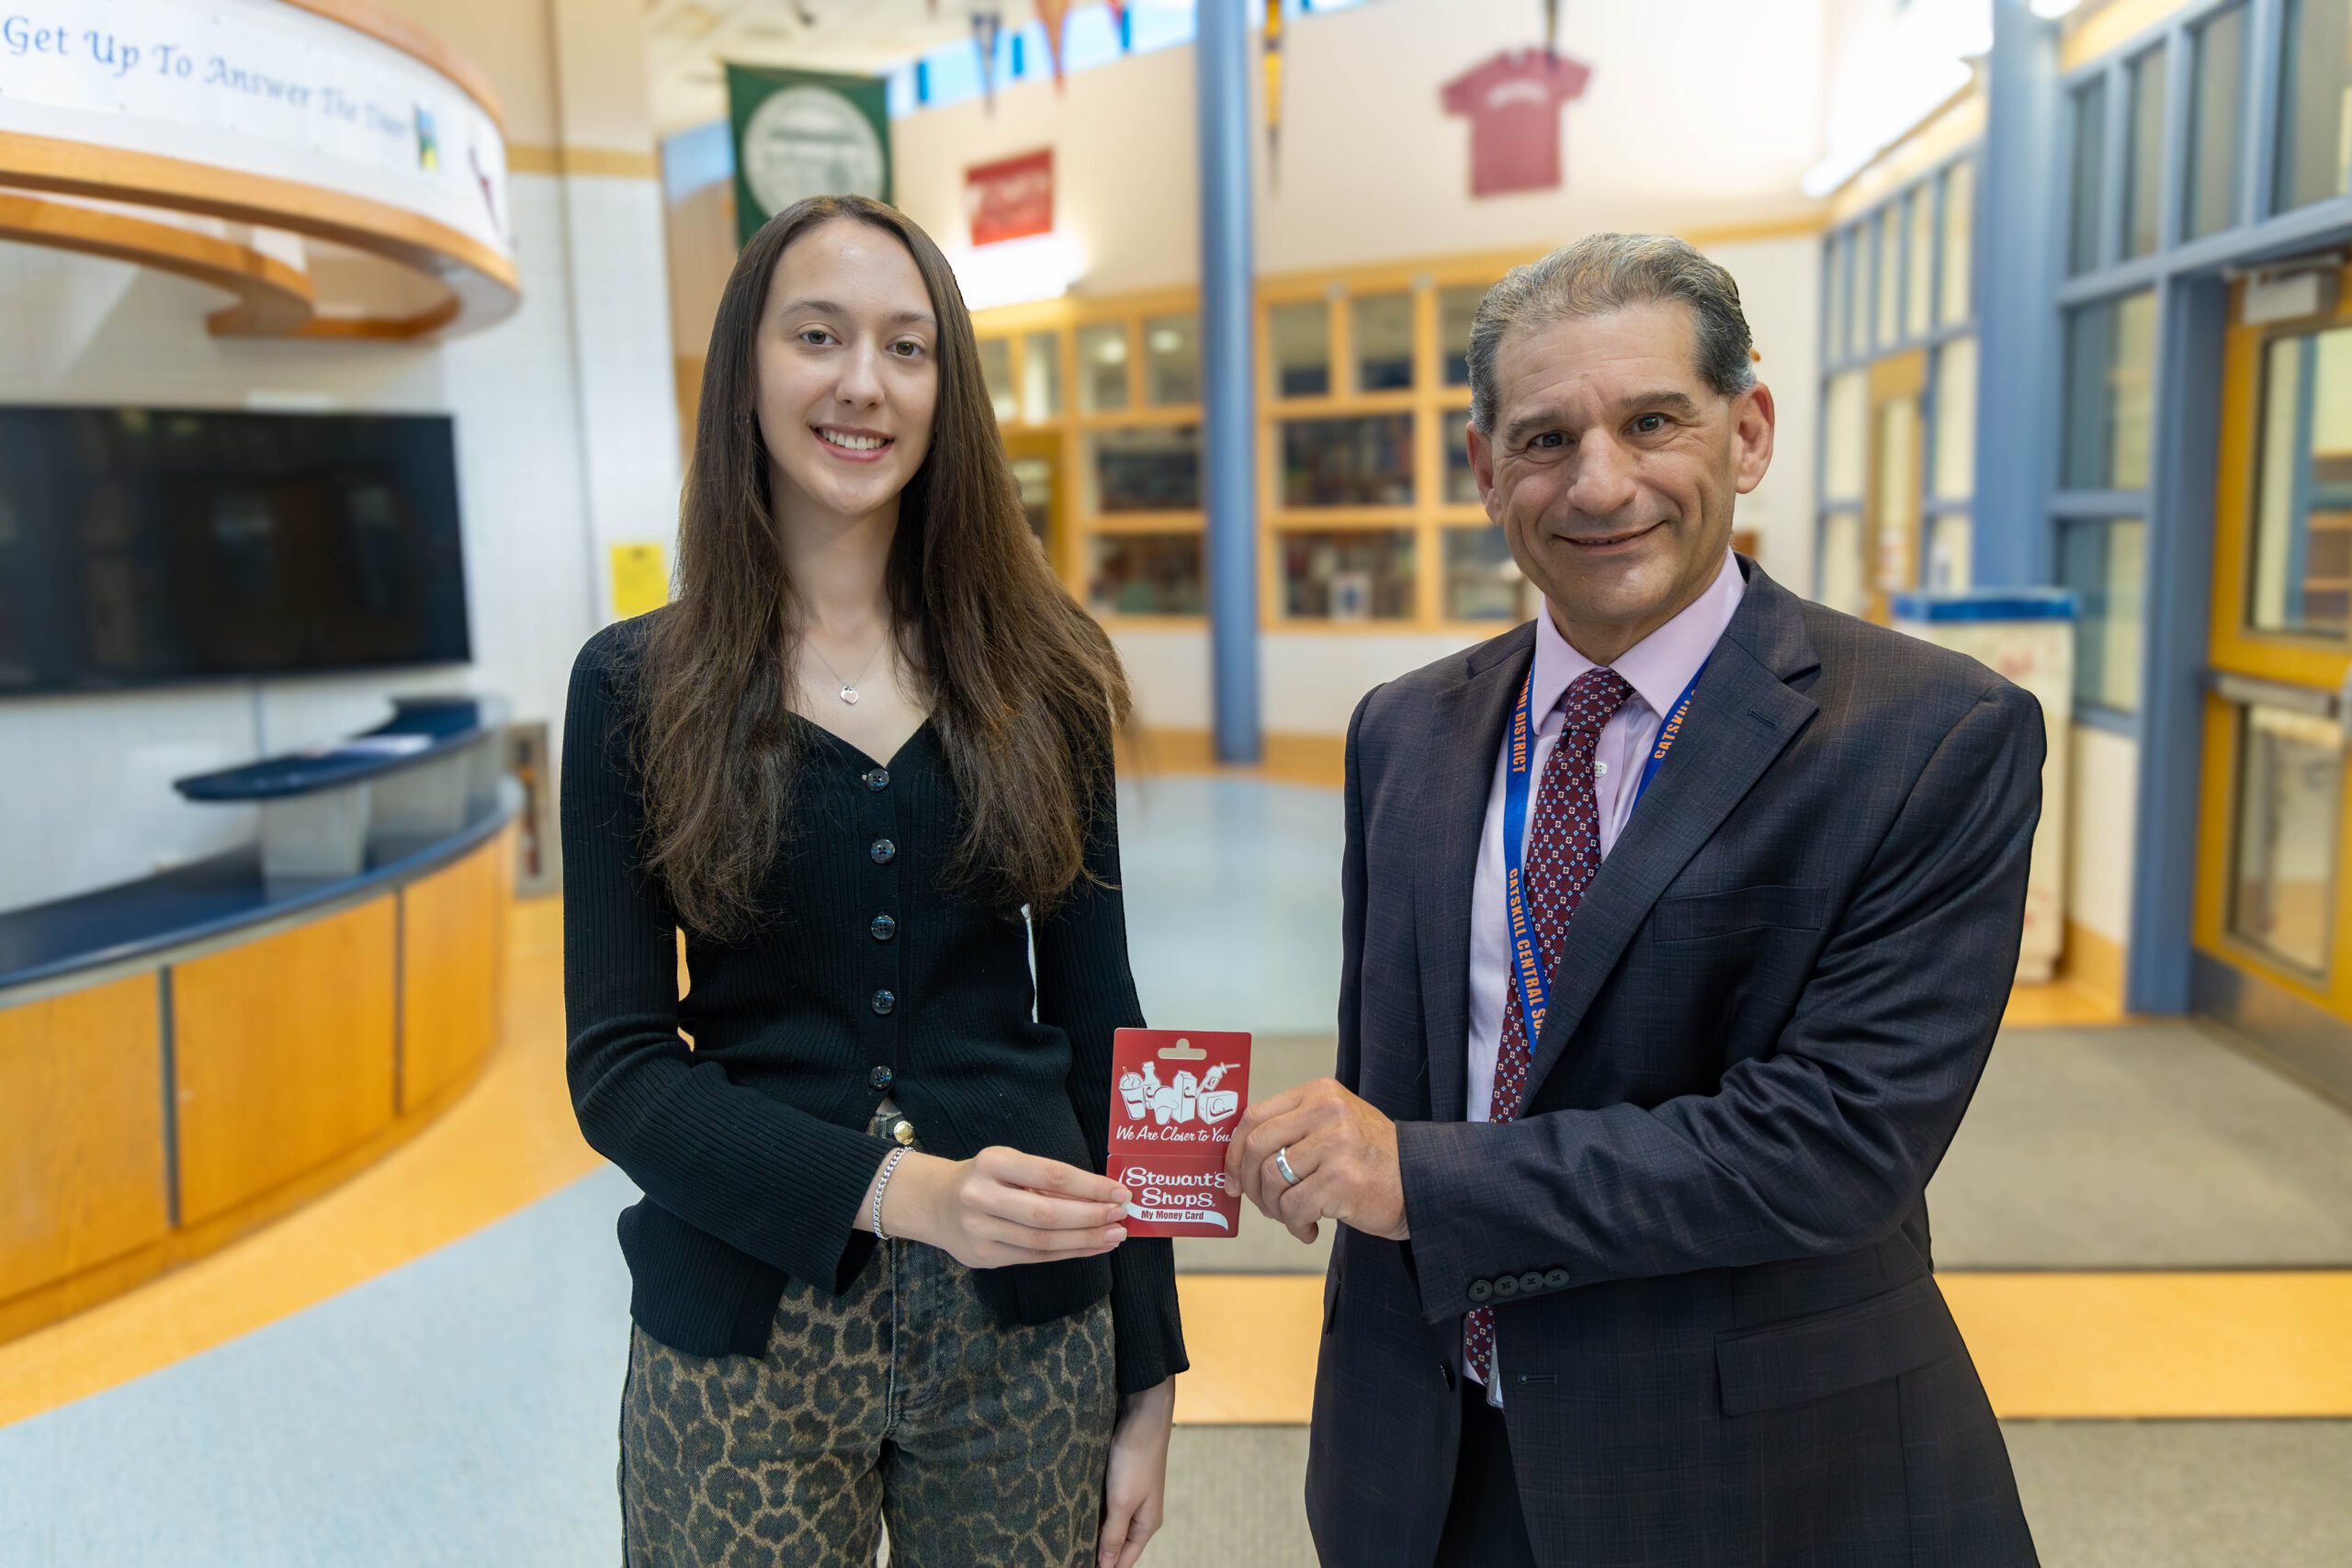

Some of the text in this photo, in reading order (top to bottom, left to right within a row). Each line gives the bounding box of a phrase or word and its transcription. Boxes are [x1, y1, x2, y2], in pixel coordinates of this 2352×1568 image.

[3, 15, 70, 56] Get
[83, 28, 141, 78] Up
[151, 41, 193, 78] To
[203, 55, 311, 107] Answer
[1512, 712, 1527, 773] DISTRICT
[1509, 867, 1526, 938] CATSKILL
[1516, 939, 1544, 1007] CENTRAL
[1116, 1125, 1135, 1140] We
[1136, 1125, 1159, 1140] Are
[1160, 1126, 1195, 1141] Closer
[1197, 1129, 1210, 1142] to
[1125, 1167, 1226, 1188] Stewart's
[1141, 1187, 1213, 1208] Shops
[1141, 1211, 1204, 1220] My Money Card
